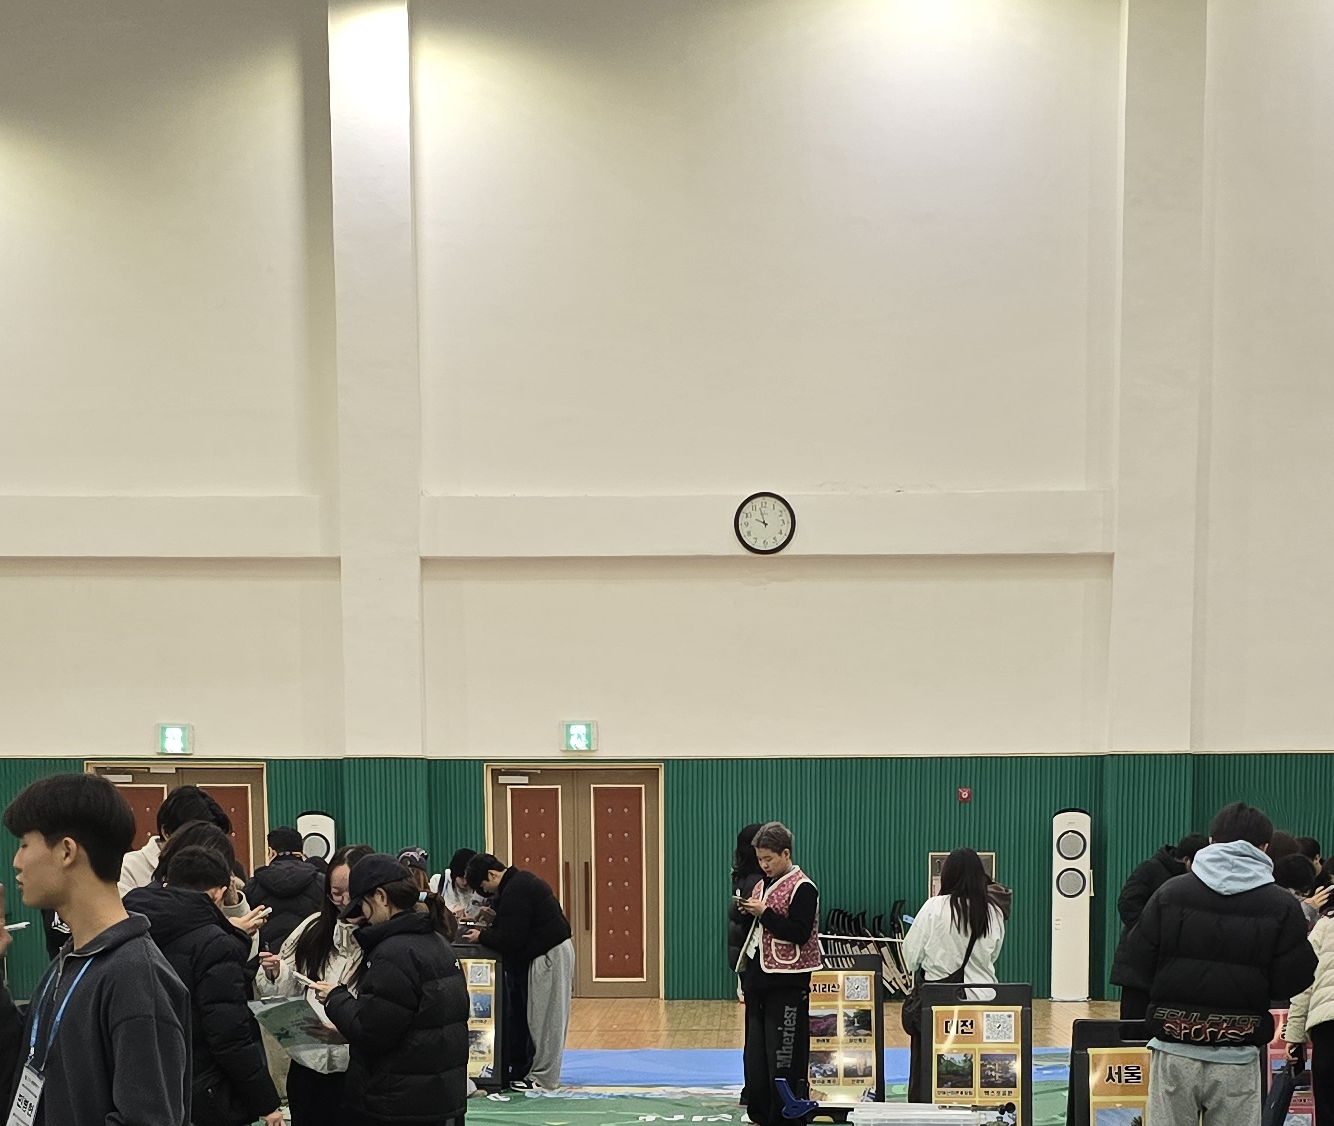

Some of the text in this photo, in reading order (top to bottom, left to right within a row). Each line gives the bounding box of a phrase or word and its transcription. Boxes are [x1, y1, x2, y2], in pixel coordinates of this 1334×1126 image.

[943, 1018, 975, 1035] 대전
[1153, 1007, 1261, 1027] SCULPTOR
[1104, 1064, 1143, 1085] 서울
